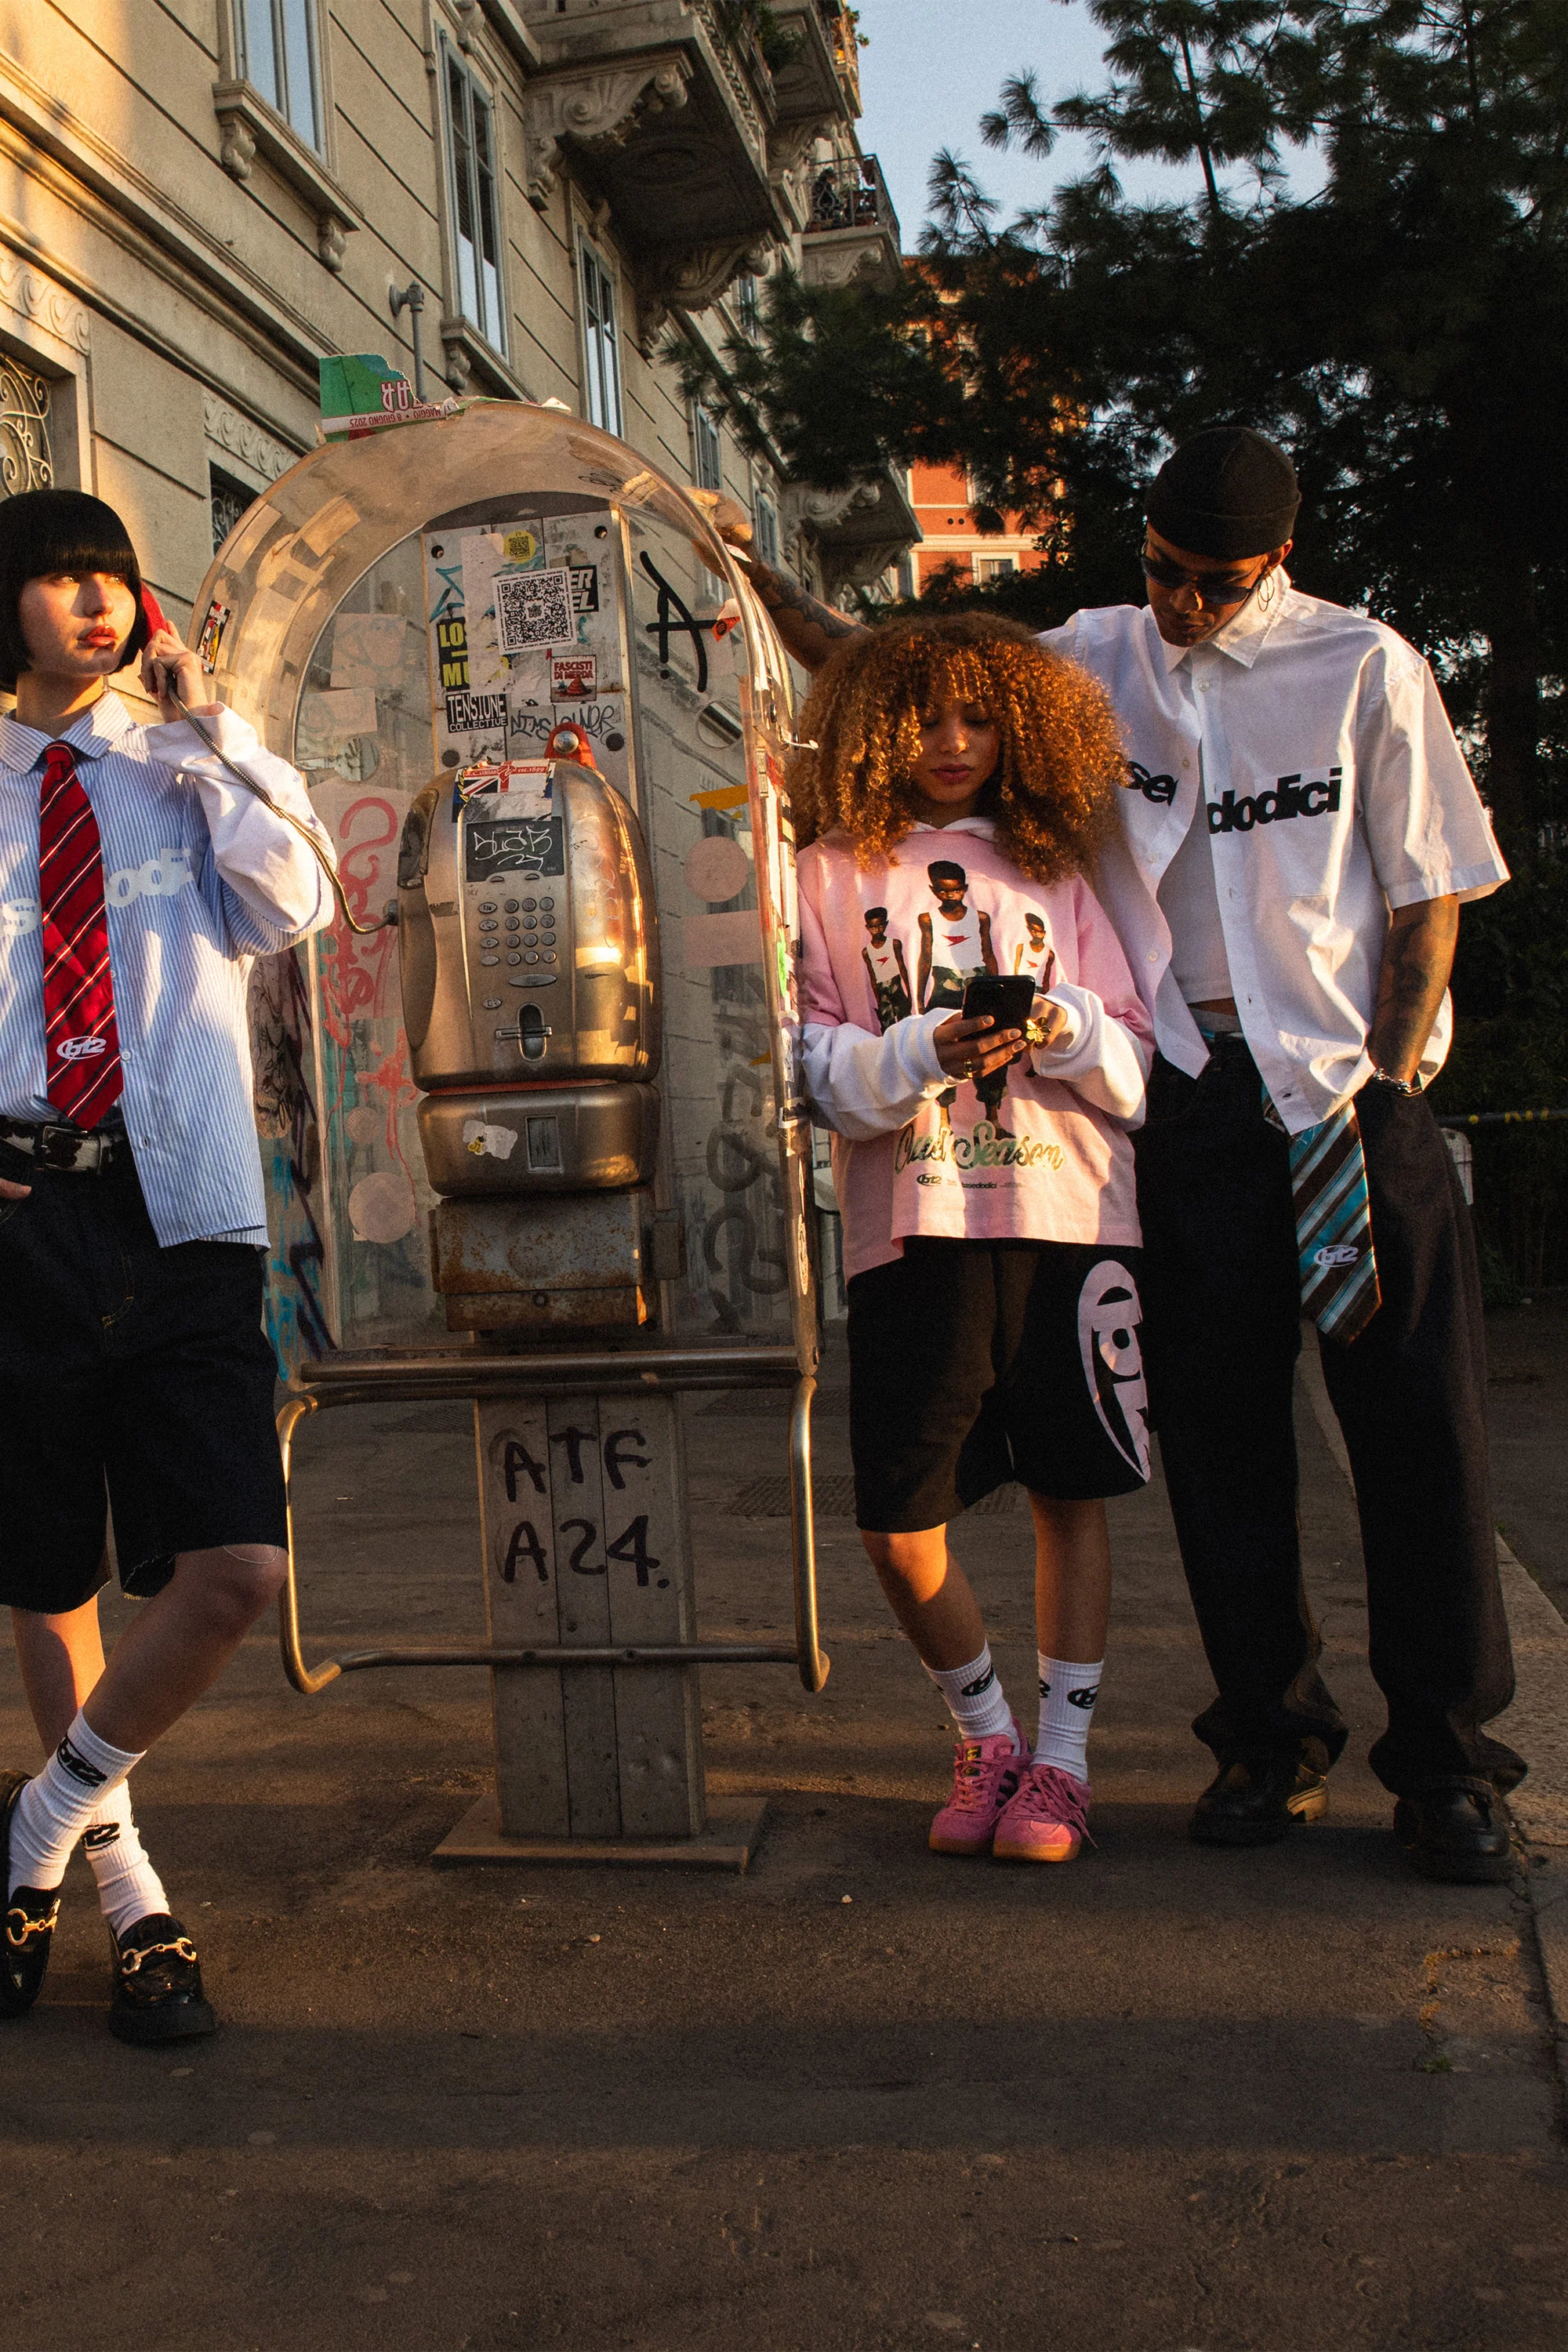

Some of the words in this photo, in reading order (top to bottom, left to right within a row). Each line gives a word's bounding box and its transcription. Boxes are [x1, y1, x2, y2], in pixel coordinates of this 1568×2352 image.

[350, 417, 367, 428] 2025
[369, 413, 396, 426] GIUGNO
[397, 412, 402, 421] 8
[414, 407, 441, 420] MAGGIO
[570, 569, 594, 591] ER
[572, 590, 595, 611] EL
[438, 621, 468, 648] LO
[554, 661, 593, 671] FASCISTI
[554, 671, 564, 680] DI
[564, 670, 593, 680] MERDA
[447, 694, 506, 724] TENSIONE
[449, 717, 507, 732] COLLECTIVE
[1207, 766, 1343, 834] dodici
[953, 1121, 1065, 1171] Season
[503, 1425, 652, 1502] ATF
